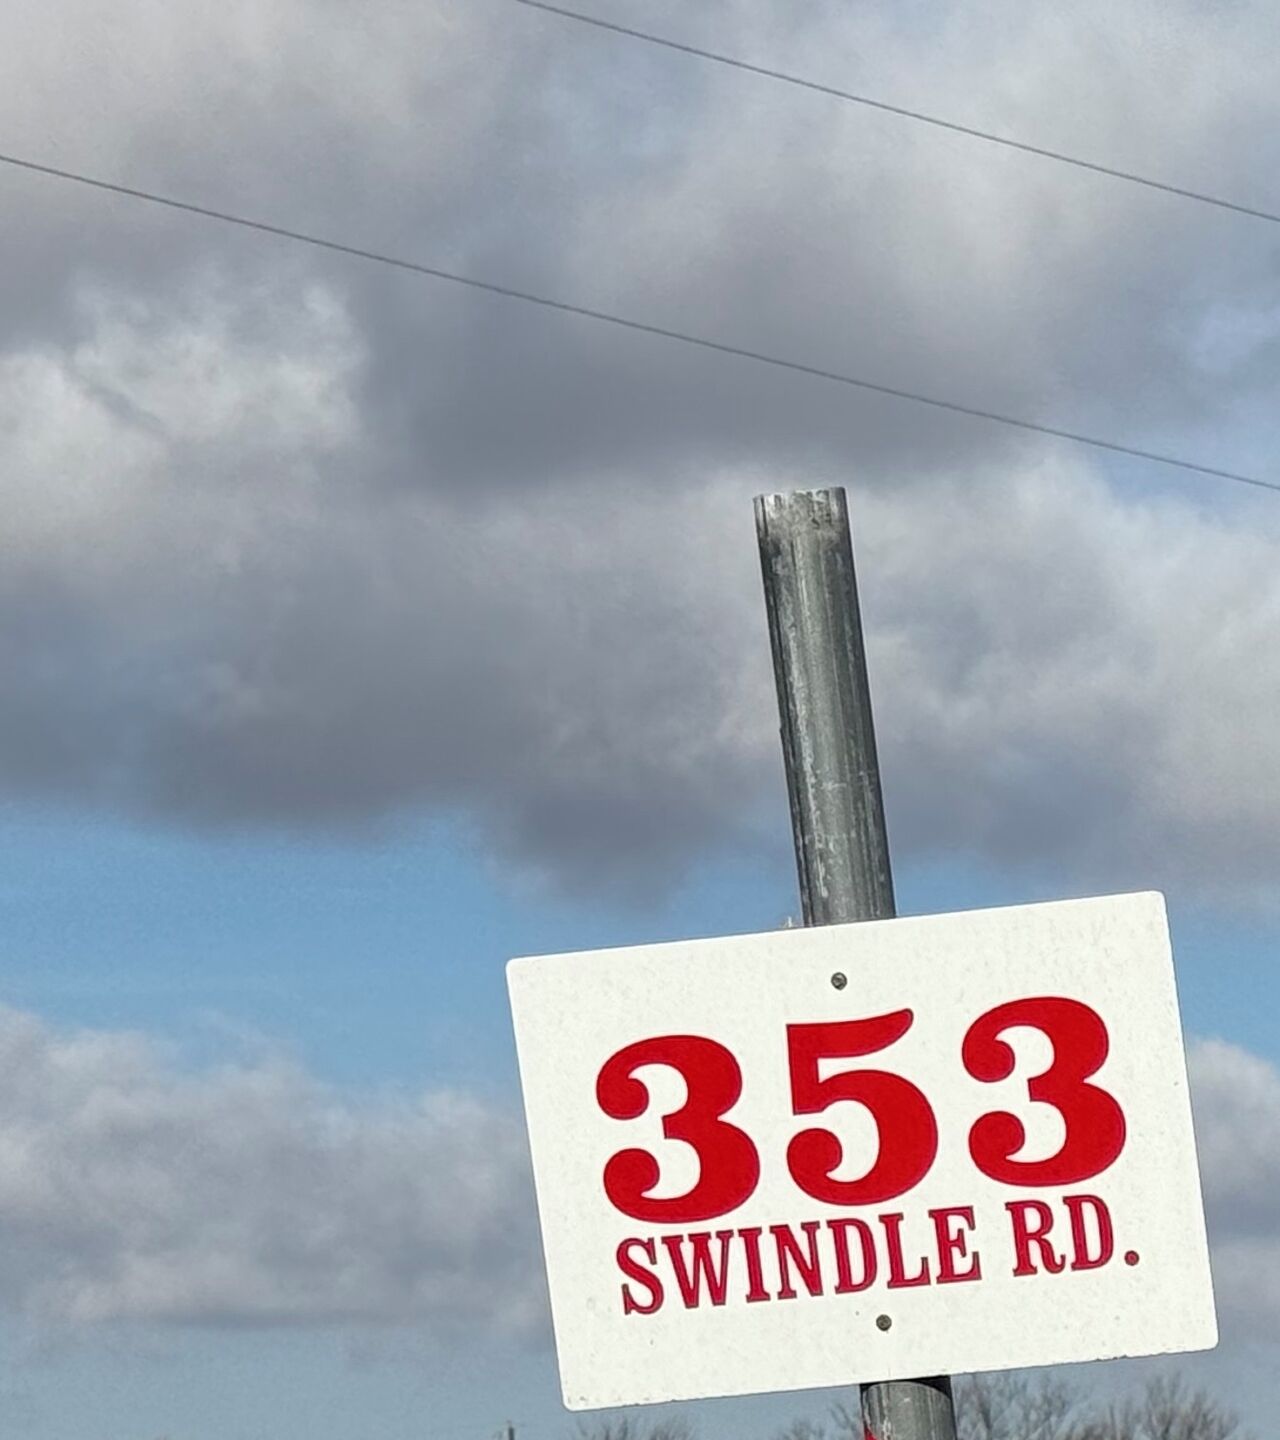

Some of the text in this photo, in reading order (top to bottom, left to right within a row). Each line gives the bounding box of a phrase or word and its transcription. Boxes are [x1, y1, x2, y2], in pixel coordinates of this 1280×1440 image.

[596, 997, 1127, 1223] 353
[615, 1194, 1140, 1316] SWINDLE RD.
